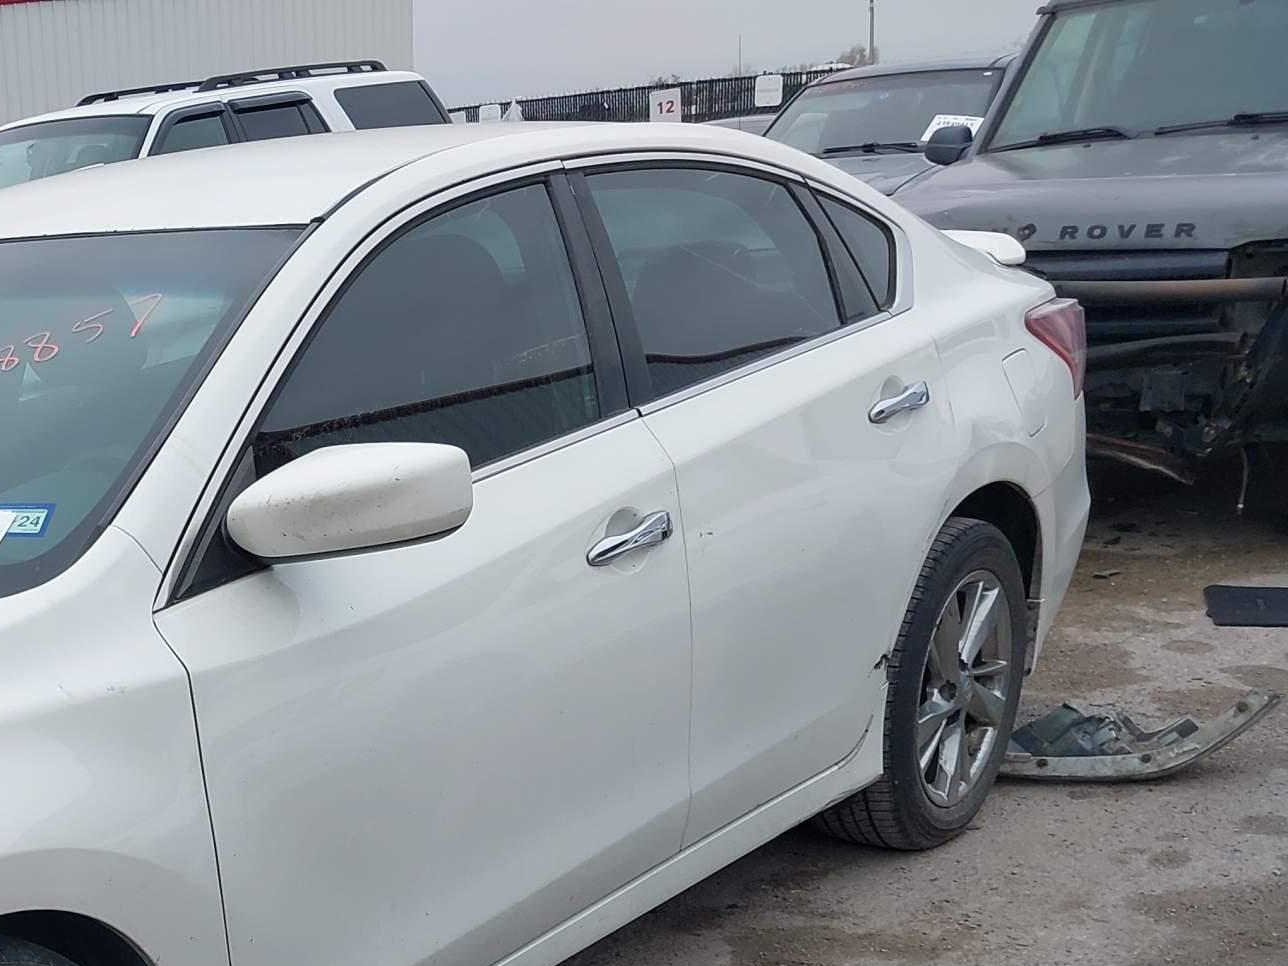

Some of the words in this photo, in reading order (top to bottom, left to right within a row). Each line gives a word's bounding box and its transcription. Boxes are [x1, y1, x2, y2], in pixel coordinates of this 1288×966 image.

[656, 99, 676, 115] 12
[1058, 222, 1197, 240] ROVER
[16, 515, 42, 528] 24
